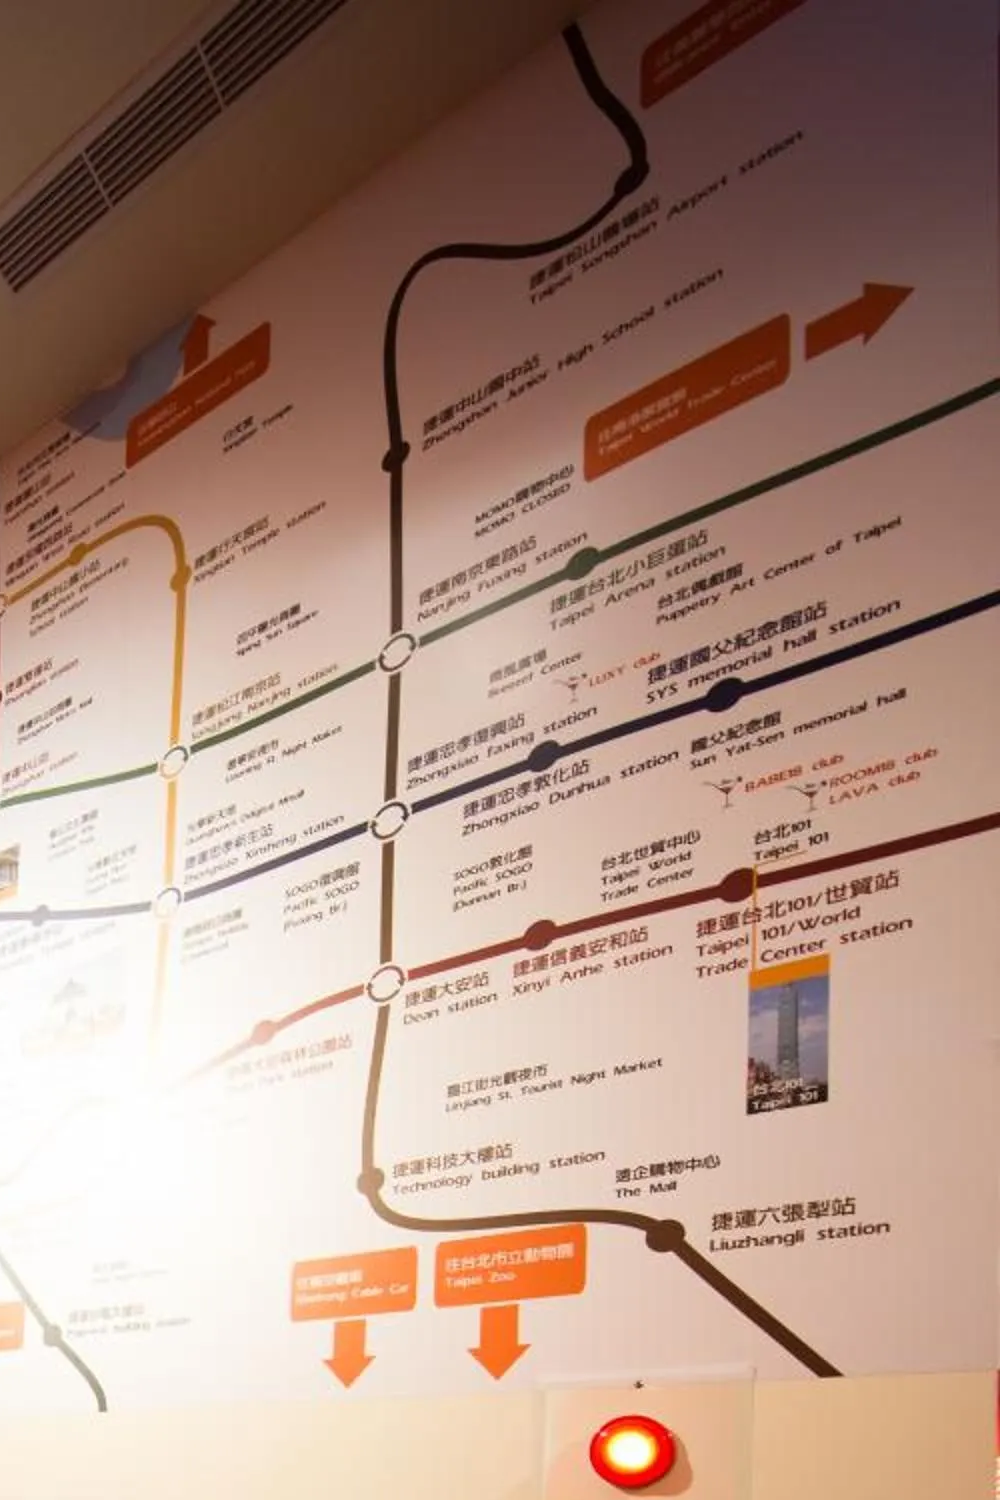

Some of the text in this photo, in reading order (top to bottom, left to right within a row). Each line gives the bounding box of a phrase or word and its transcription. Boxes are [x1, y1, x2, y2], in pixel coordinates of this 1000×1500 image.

[738, 127, 803, 176] station
[557, 343, 594, 372] High
[600, 305, 654, 347] School
[664, 266, 724, 311] station
[535, 531, 589, 565] station
[729, 577, 759, 597] Art
[762, 551, 818, 582] Center
[824, 538, 845, 557] of
[852, 515, 904, 544] Taipei
[549, 544, 728, 631] Taipei Arena station
[644, 598, 902, 707] SYS memorial hall station
[542, 705, 600, 736] station
[688, 752, 717, 773] Sun
[792, 699, 871, 736] memorial
[874, 686, 908, 709] hall
[811, 751, 846, 774] club
[903, 746, 939, 768] club
[460, 750, 681, 839] Zhongxiao Dunhua station
[887, 769, 923, 789] club
[755, 830, 831, 862] Taipei 101
[495, 860, 534, 883] SOGO
[601, 849, 694, 888] Taipei World
[601, 866, 696, 904] Trade Center
[694, 905, 862, 959] Taipei 101/World
[694, 917, 915, 981] Trade Center station
[559, 953, 606, 984] Anhe
[612, 943, 677, 975] station
[446, 992, 500, 1015] station
[613, 1056, 663, 1077] Market
[391, 1148, 608, 1197] Technology building station
[614, 1180, 681, 1200] The Mall
[708, 1218, 892, 1254] Liuzhangli station
[444, 1270, 520, 1292] Taipei Zoo
